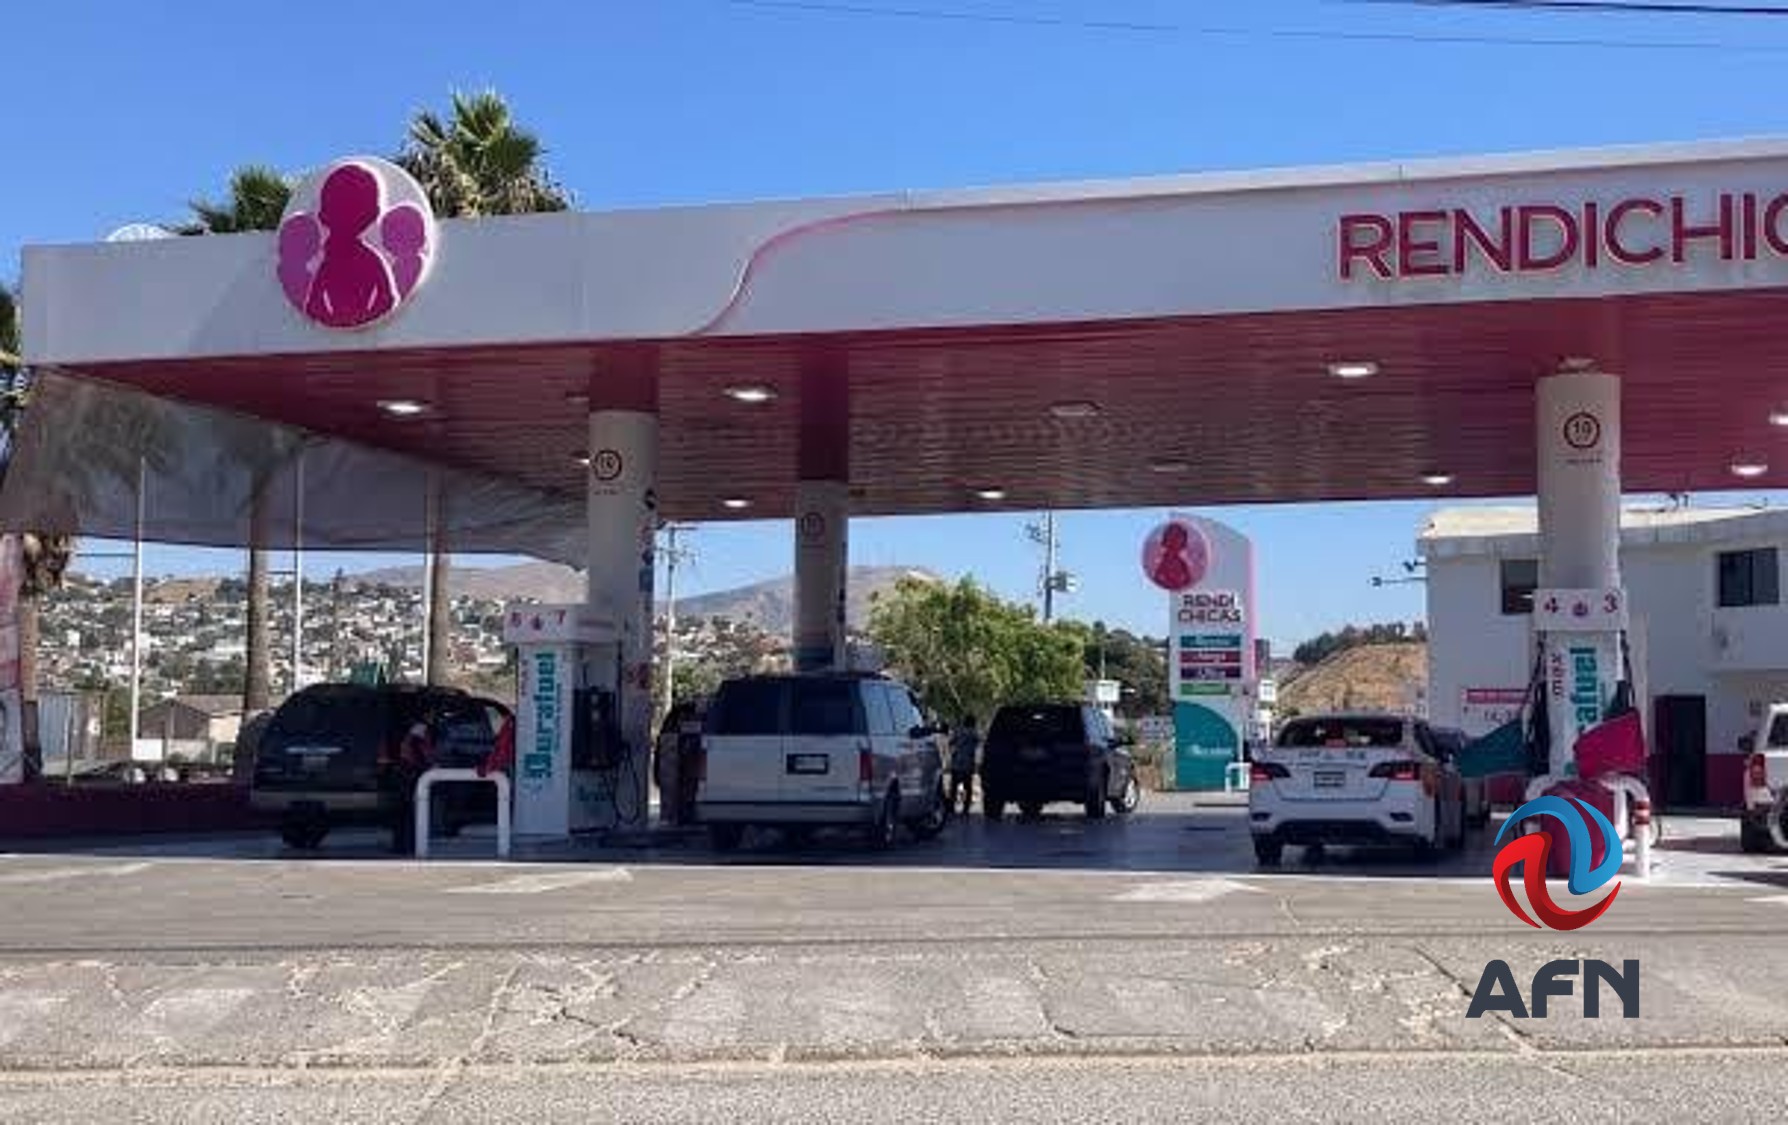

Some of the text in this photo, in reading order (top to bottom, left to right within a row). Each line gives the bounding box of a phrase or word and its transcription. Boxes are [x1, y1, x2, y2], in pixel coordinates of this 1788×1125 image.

[1182, 593, 1236, 608] RENDI
[1545, 592, 1617, 613] 4 3
[1178, 608, 1241, 622] CHICAS
[524, 653, 556, 778] Durafuel
